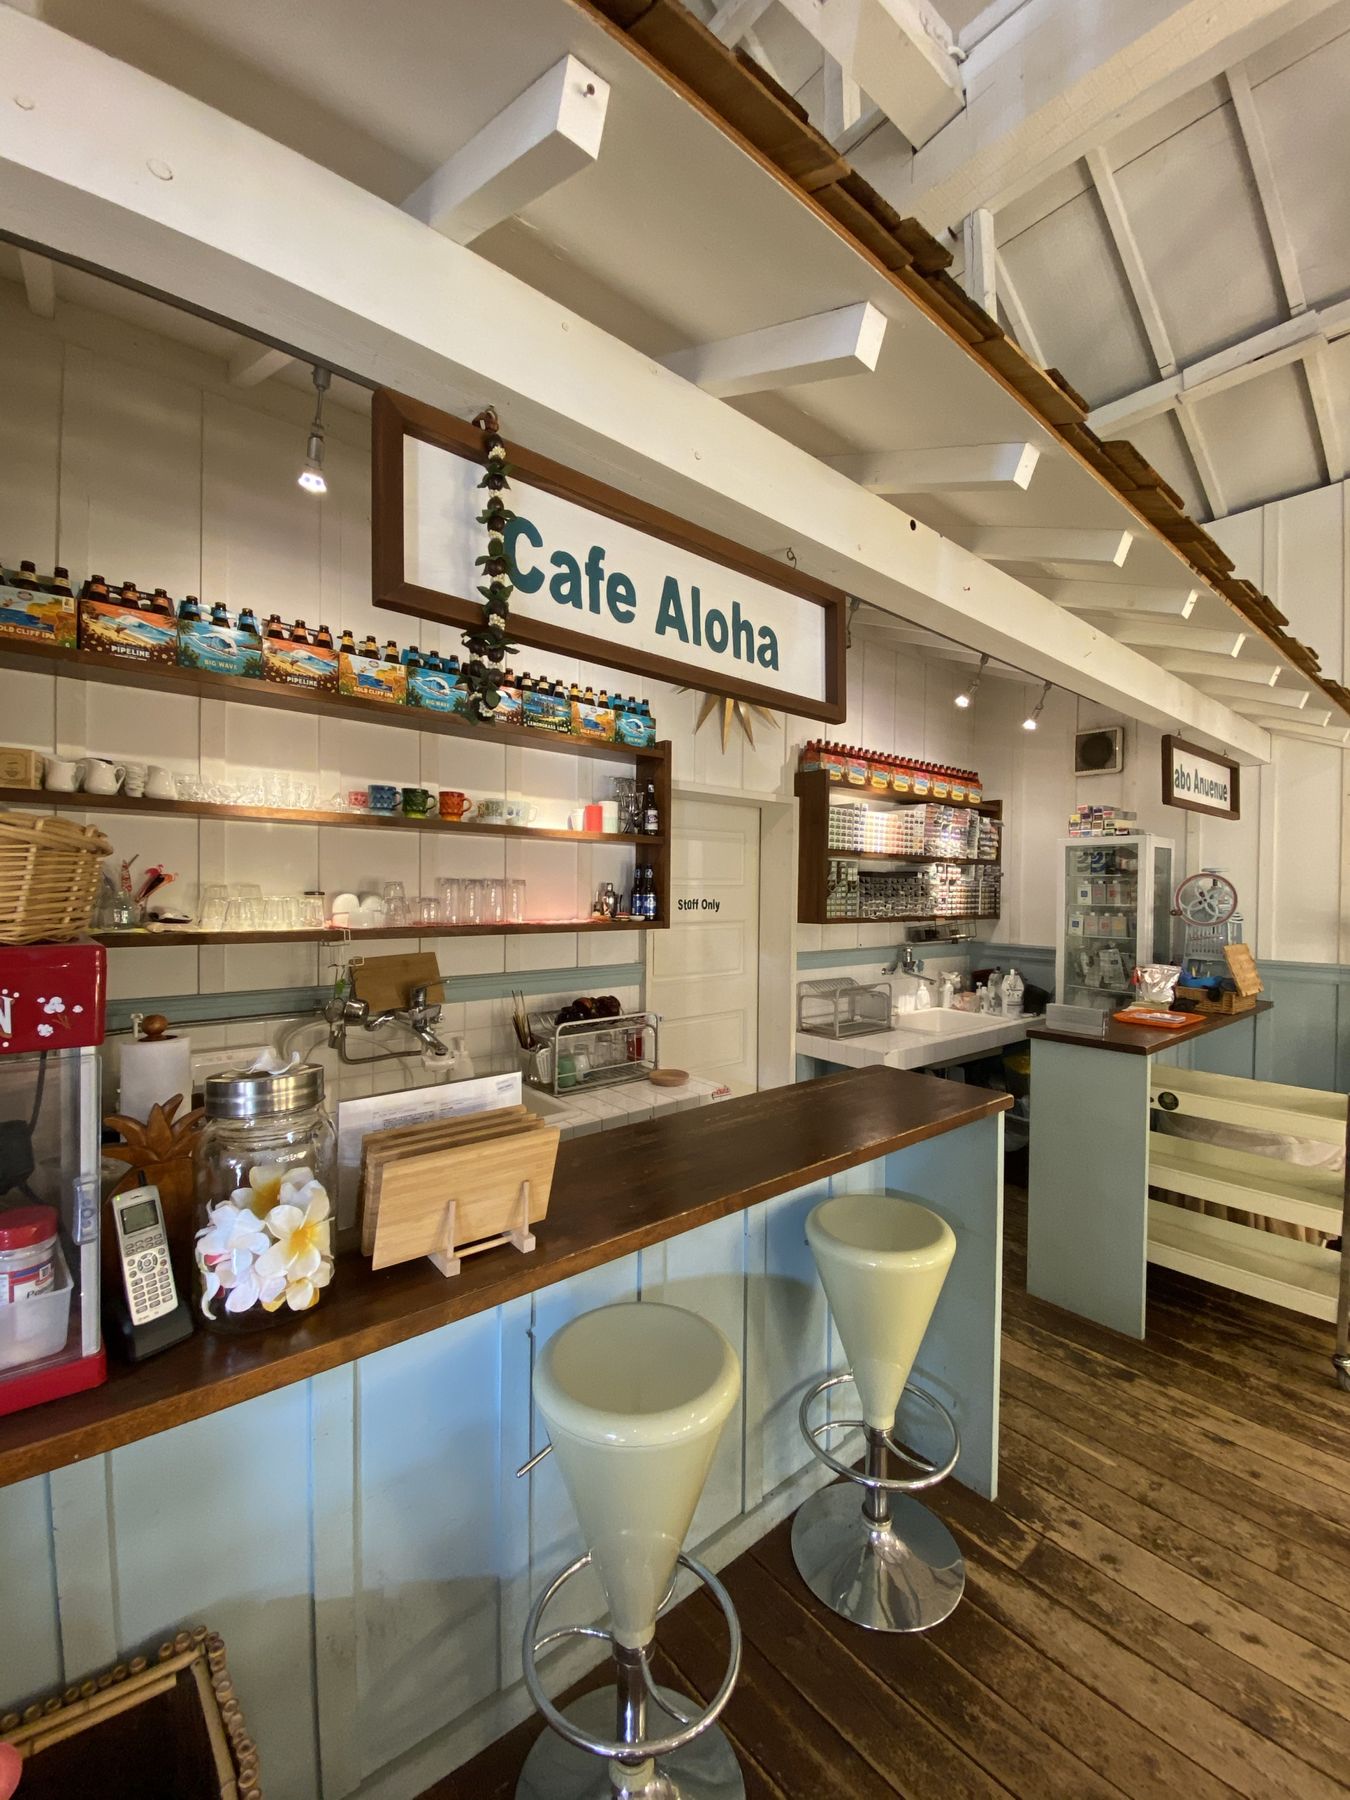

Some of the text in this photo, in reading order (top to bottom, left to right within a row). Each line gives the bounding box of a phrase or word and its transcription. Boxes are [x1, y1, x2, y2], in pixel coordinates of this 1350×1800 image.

[503, 516, 779, 671] Cafe Aloha
[16, 628, 40, 637] CLIFF
[42, 631, 56, 640] IPA
[111, 645, 150, 658] PIPELINE
[204, 659, 238, 670] BIG WAVE
[287, 675, 318, 687] PIPELINE
[1193, 768, 1228, 802] Anuenue
[677, 898, 720, 913] Staff Only
